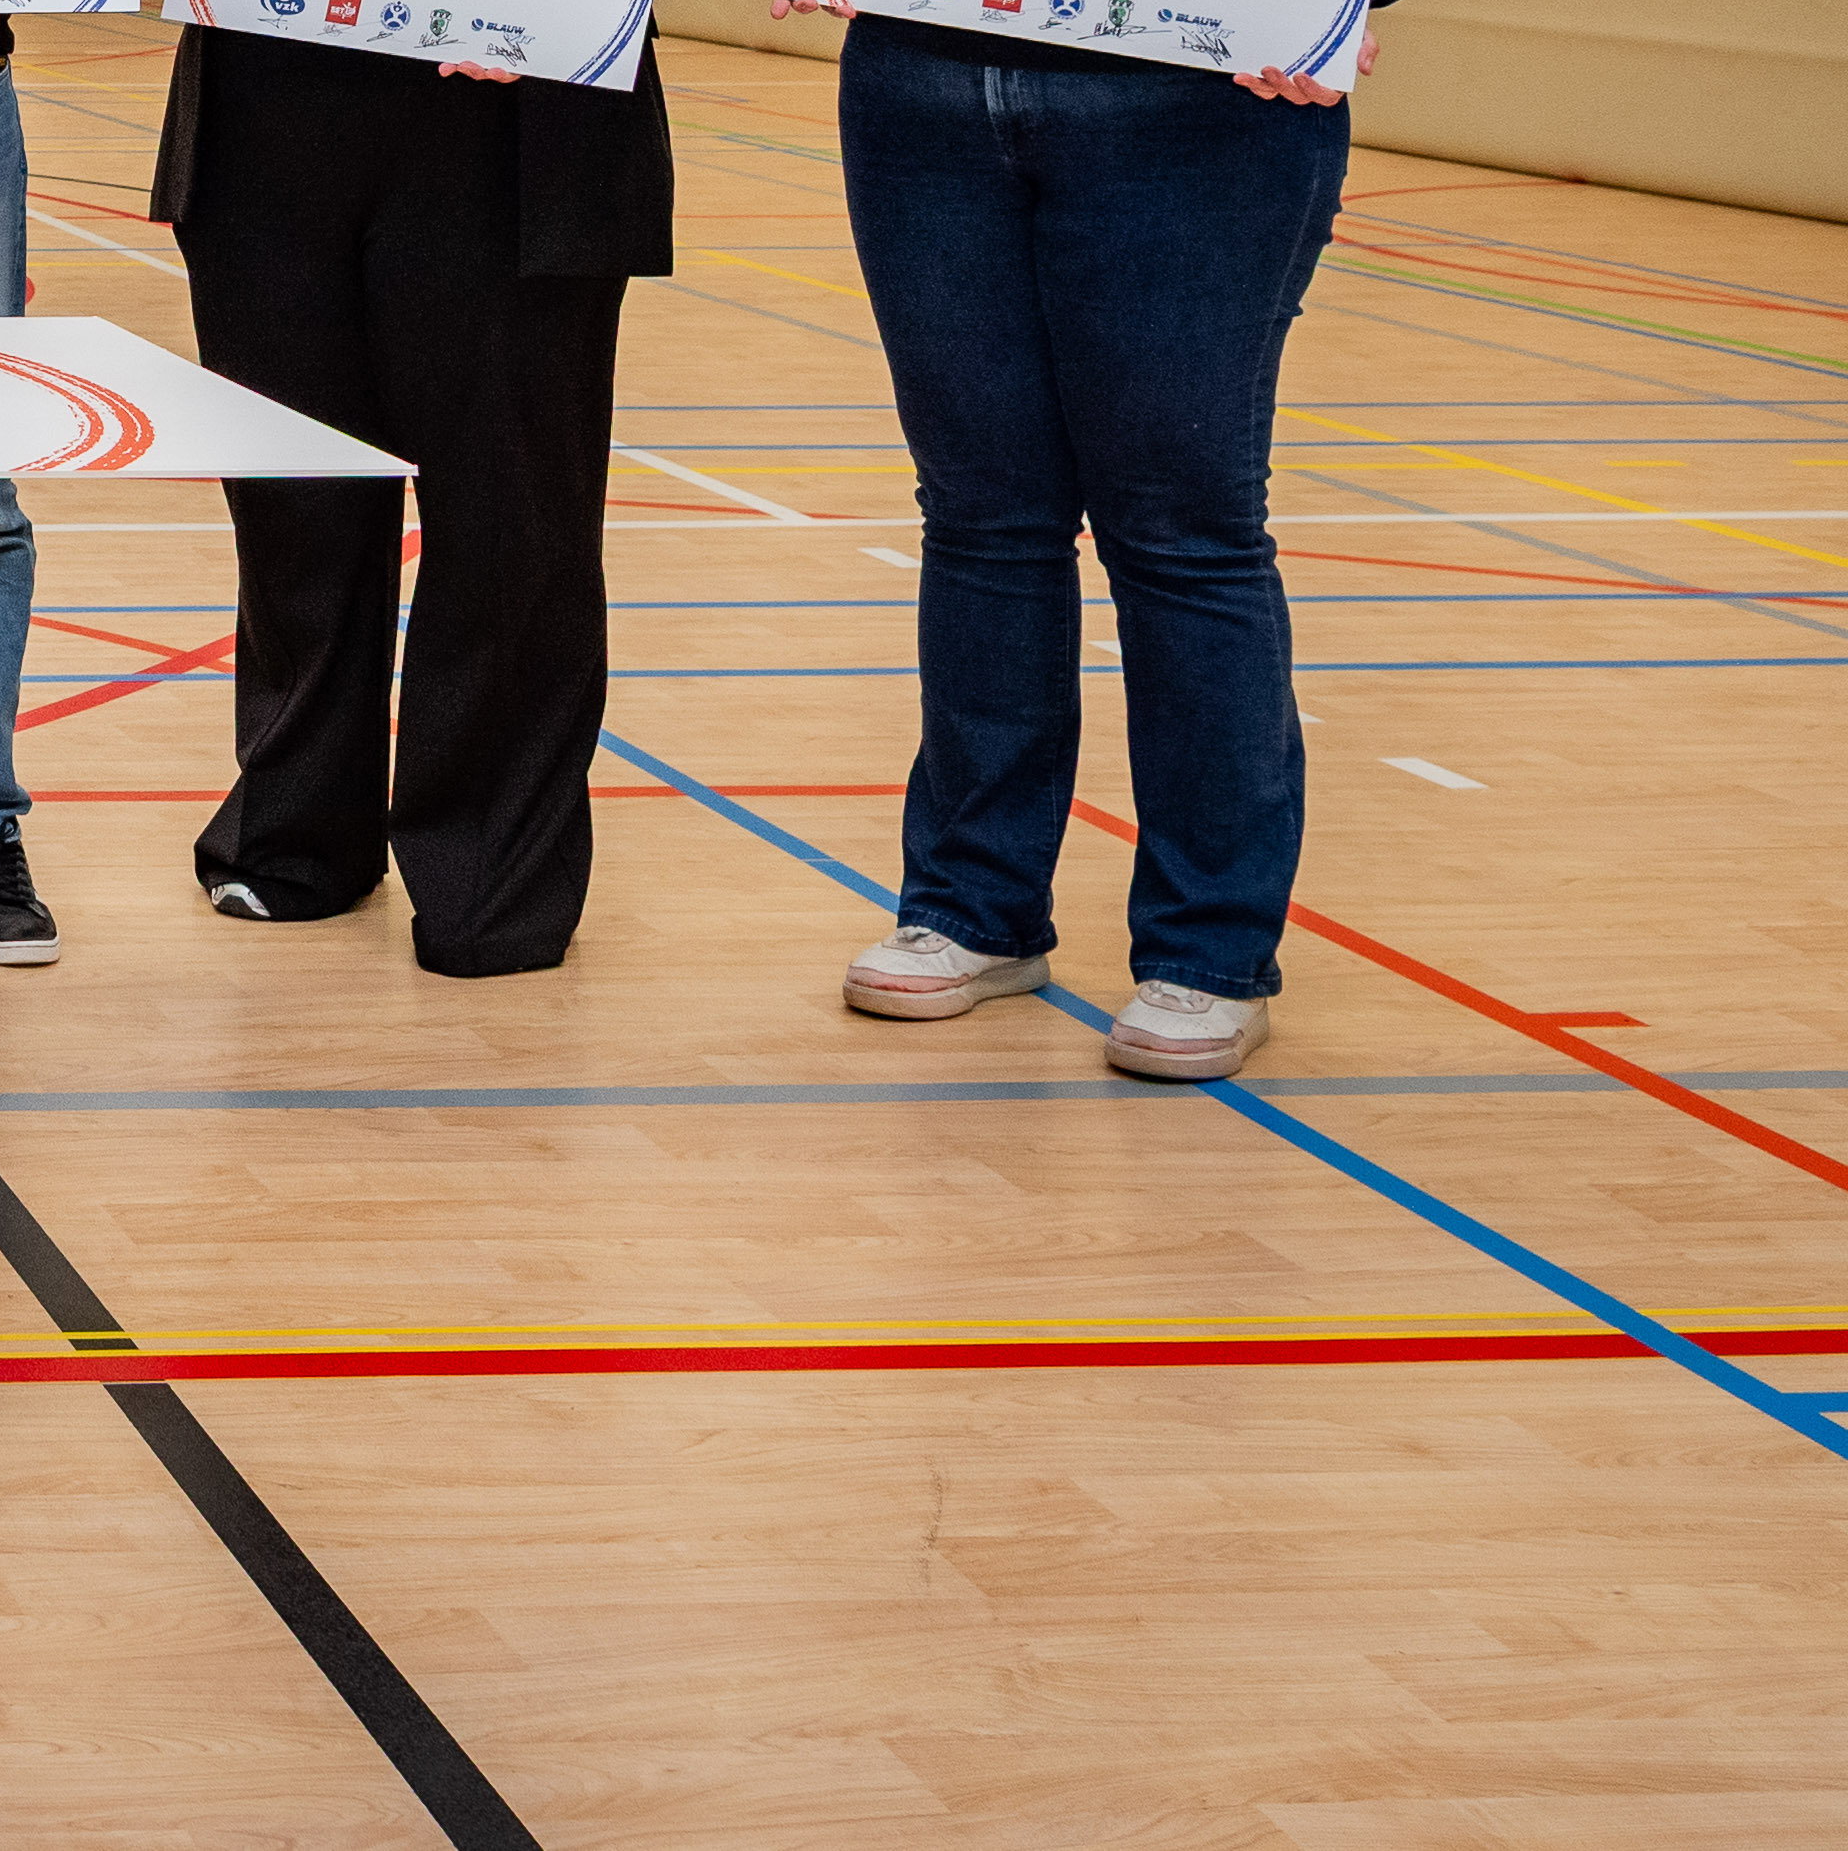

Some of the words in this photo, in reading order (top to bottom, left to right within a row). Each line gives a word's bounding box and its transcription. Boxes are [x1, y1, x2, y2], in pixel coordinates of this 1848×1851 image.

[274, 0, 300, 13] vzk
[1175, 12, 1222, 29] BLAUW
[485, 21, 526, 36] BLAUW
